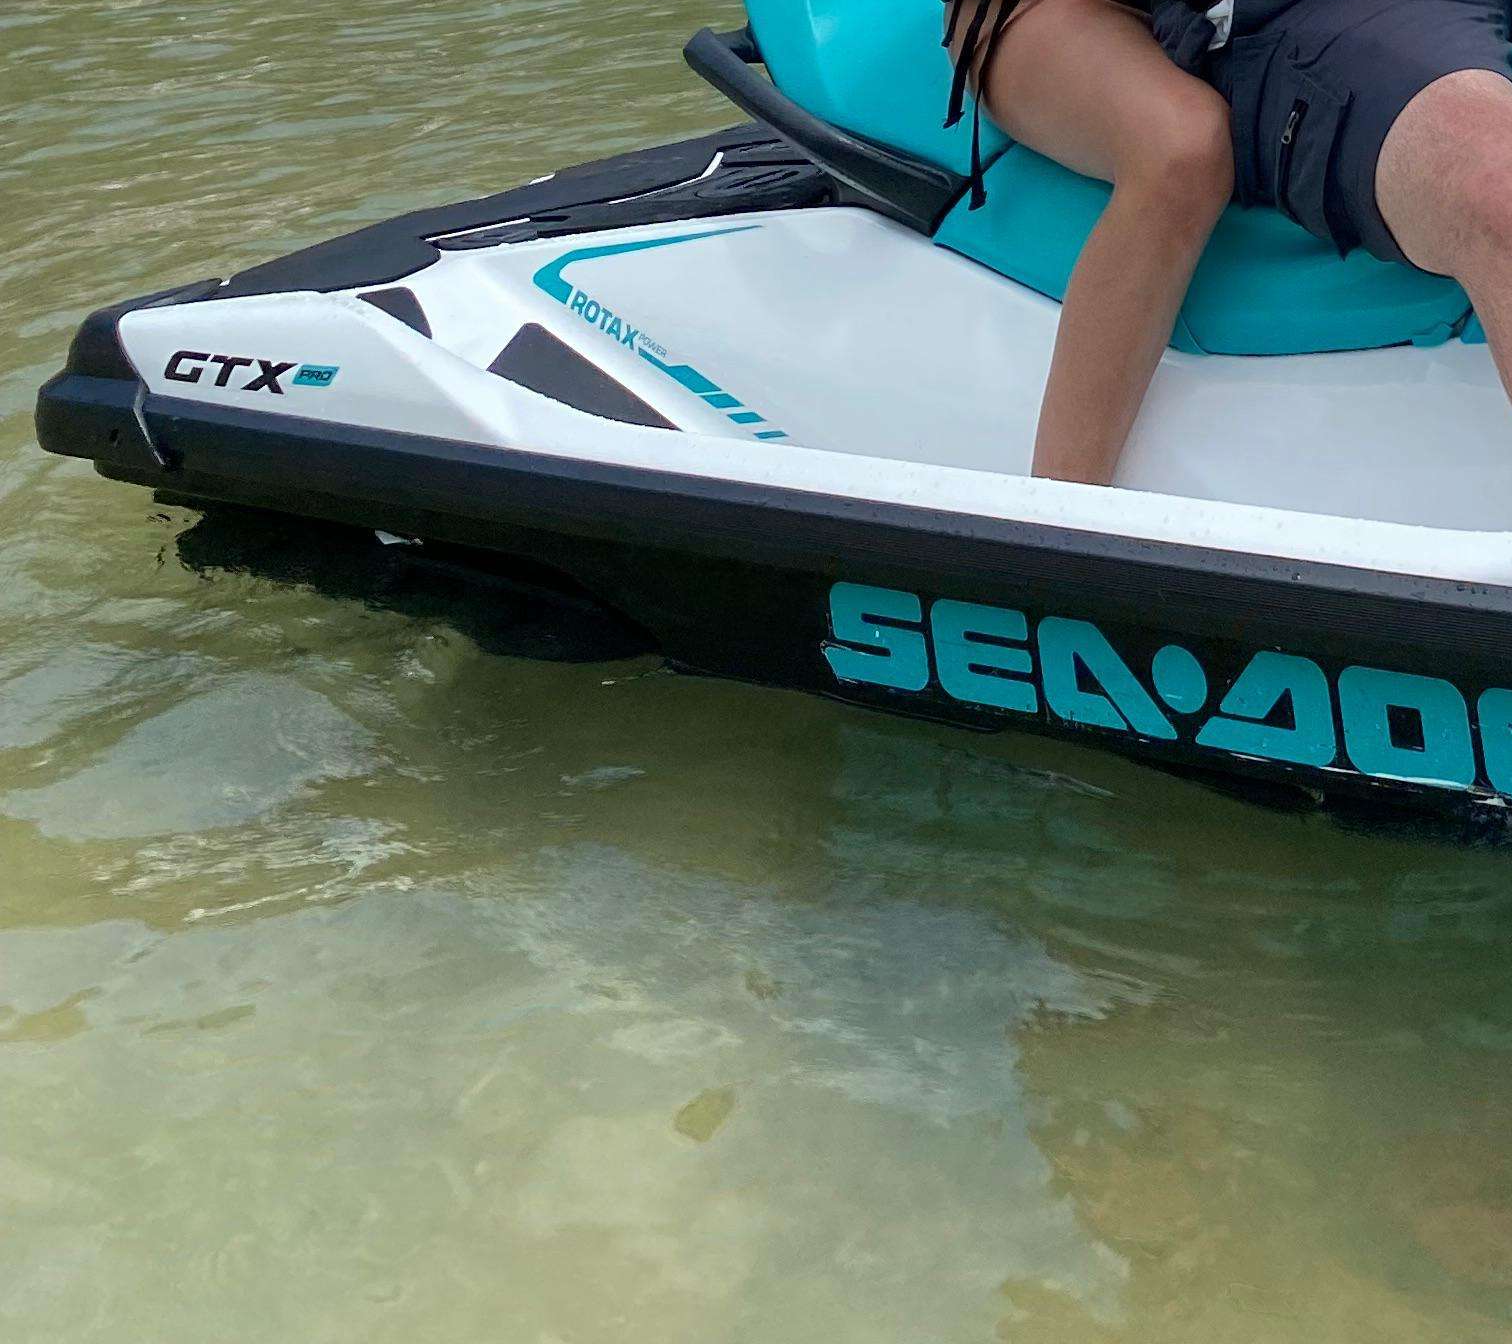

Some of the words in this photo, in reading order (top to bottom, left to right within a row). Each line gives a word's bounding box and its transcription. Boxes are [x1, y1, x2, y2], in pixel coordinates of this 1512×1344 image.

[570, 290, 640, 351] ROTAX
[639, 333, 668, 358] POWER
[164, 350, 299, 395] GTX
[299, 368, 334, 382] PRO
